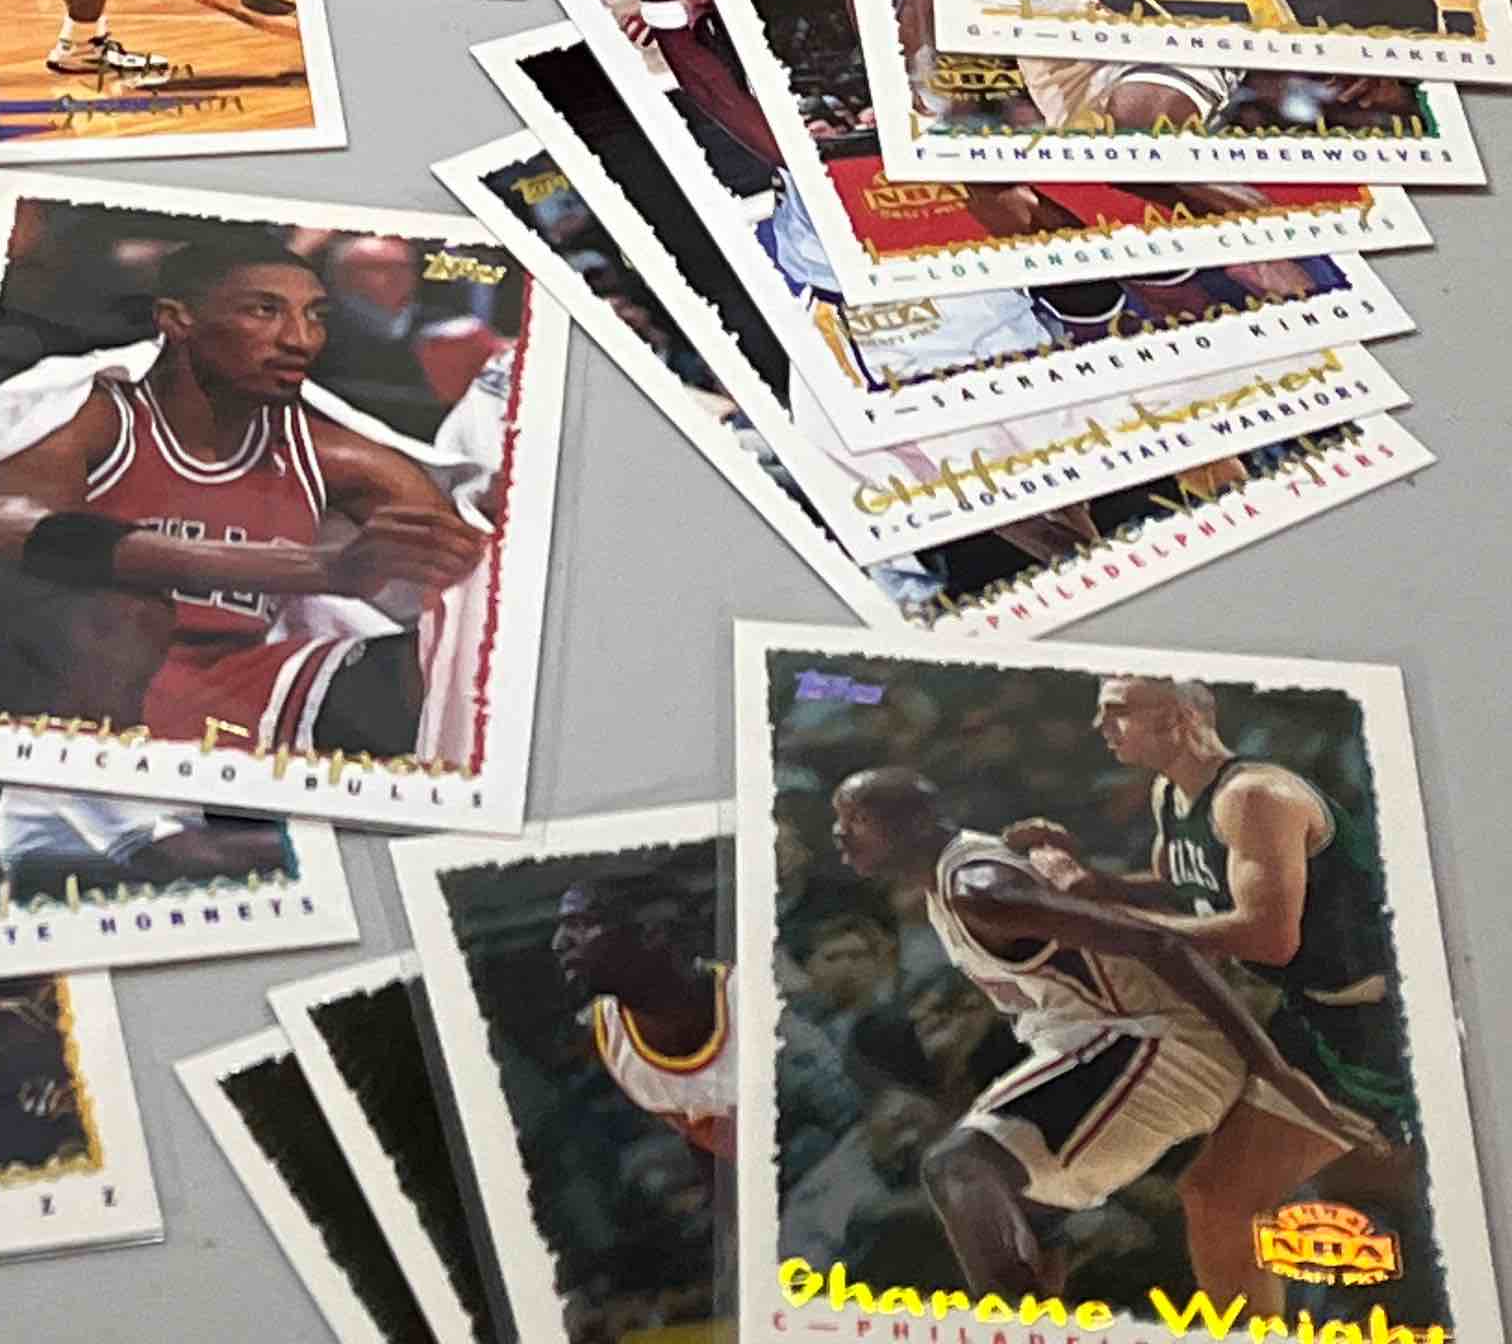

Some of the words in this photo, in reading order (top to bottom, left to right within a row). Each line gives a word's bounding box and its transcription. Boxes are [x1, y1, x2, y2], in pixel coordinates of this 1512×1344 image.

[1165, 34, 1326, 56] ANGELES
[1360, 45, 1497, 65] LAKERS
[1189, 147, 1454, 163] TIMBERWOLVES
[1023, 238, 1185, 270] ANGELES
[1218, 217, 1396, 249] CLIPPERS
[1248, 300, 1375, 338] KINGS
[1100, 432, 1194, 472] STATE
[1211, 379, 1371, 436] WARRIORS
[304, 775, 484, 809] BULLS
[100, 895, 314, 936] HORNETS
